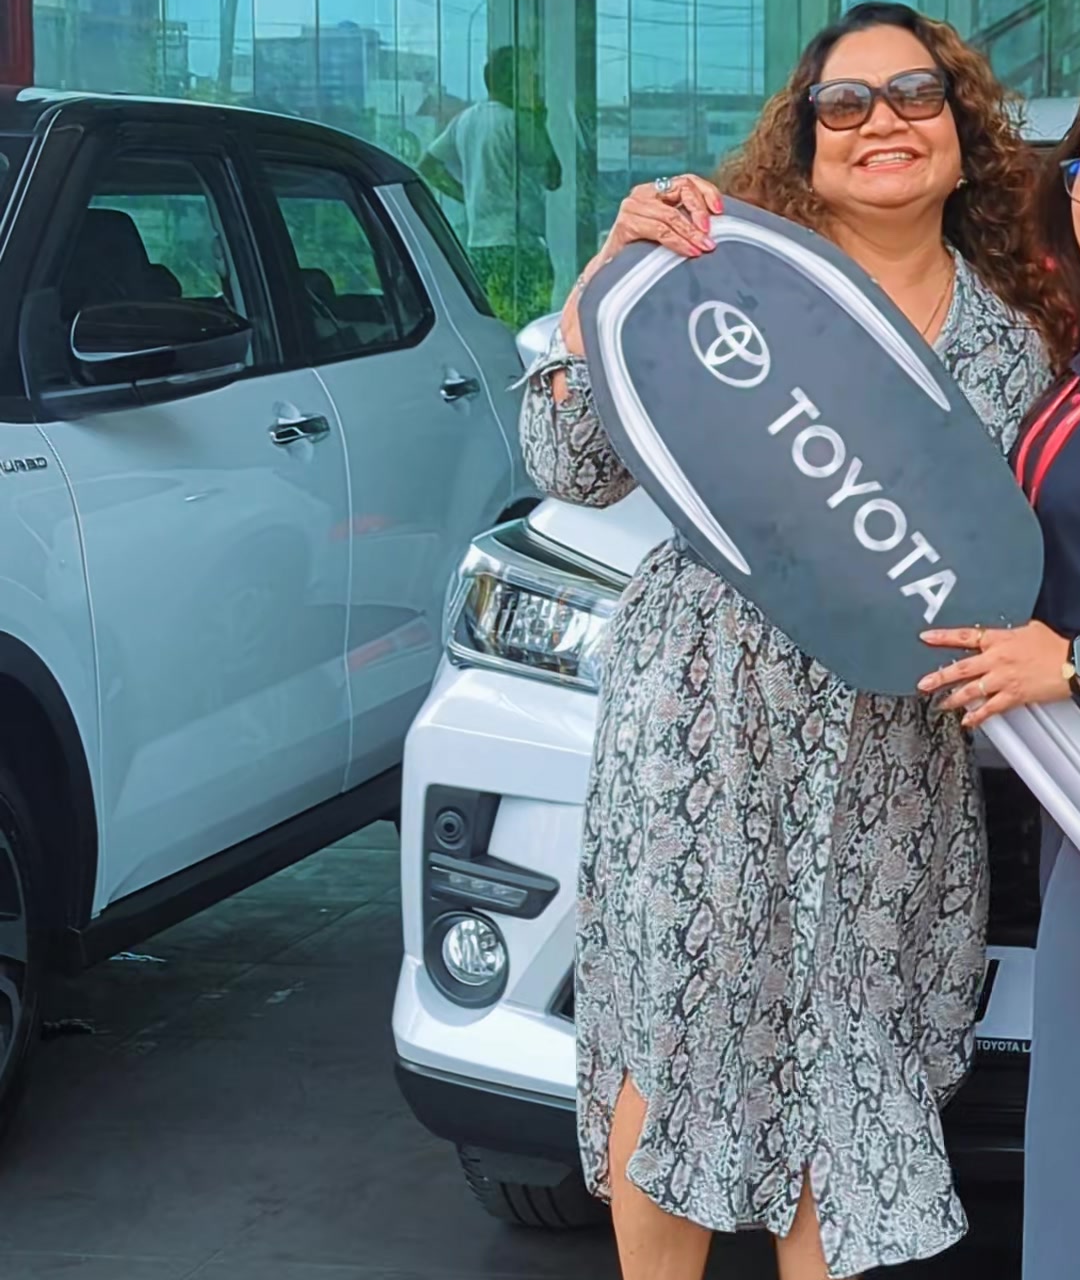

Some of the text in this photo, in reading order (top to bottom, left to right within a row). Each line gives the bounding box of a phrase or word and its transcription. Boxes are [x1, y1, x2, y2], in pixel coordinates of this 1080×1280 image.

[0, 456, 48, 473] URBO
[767, 386, 958, 625] TOYOTA
[976, 1039, 1020, 1052] TOYOTA
